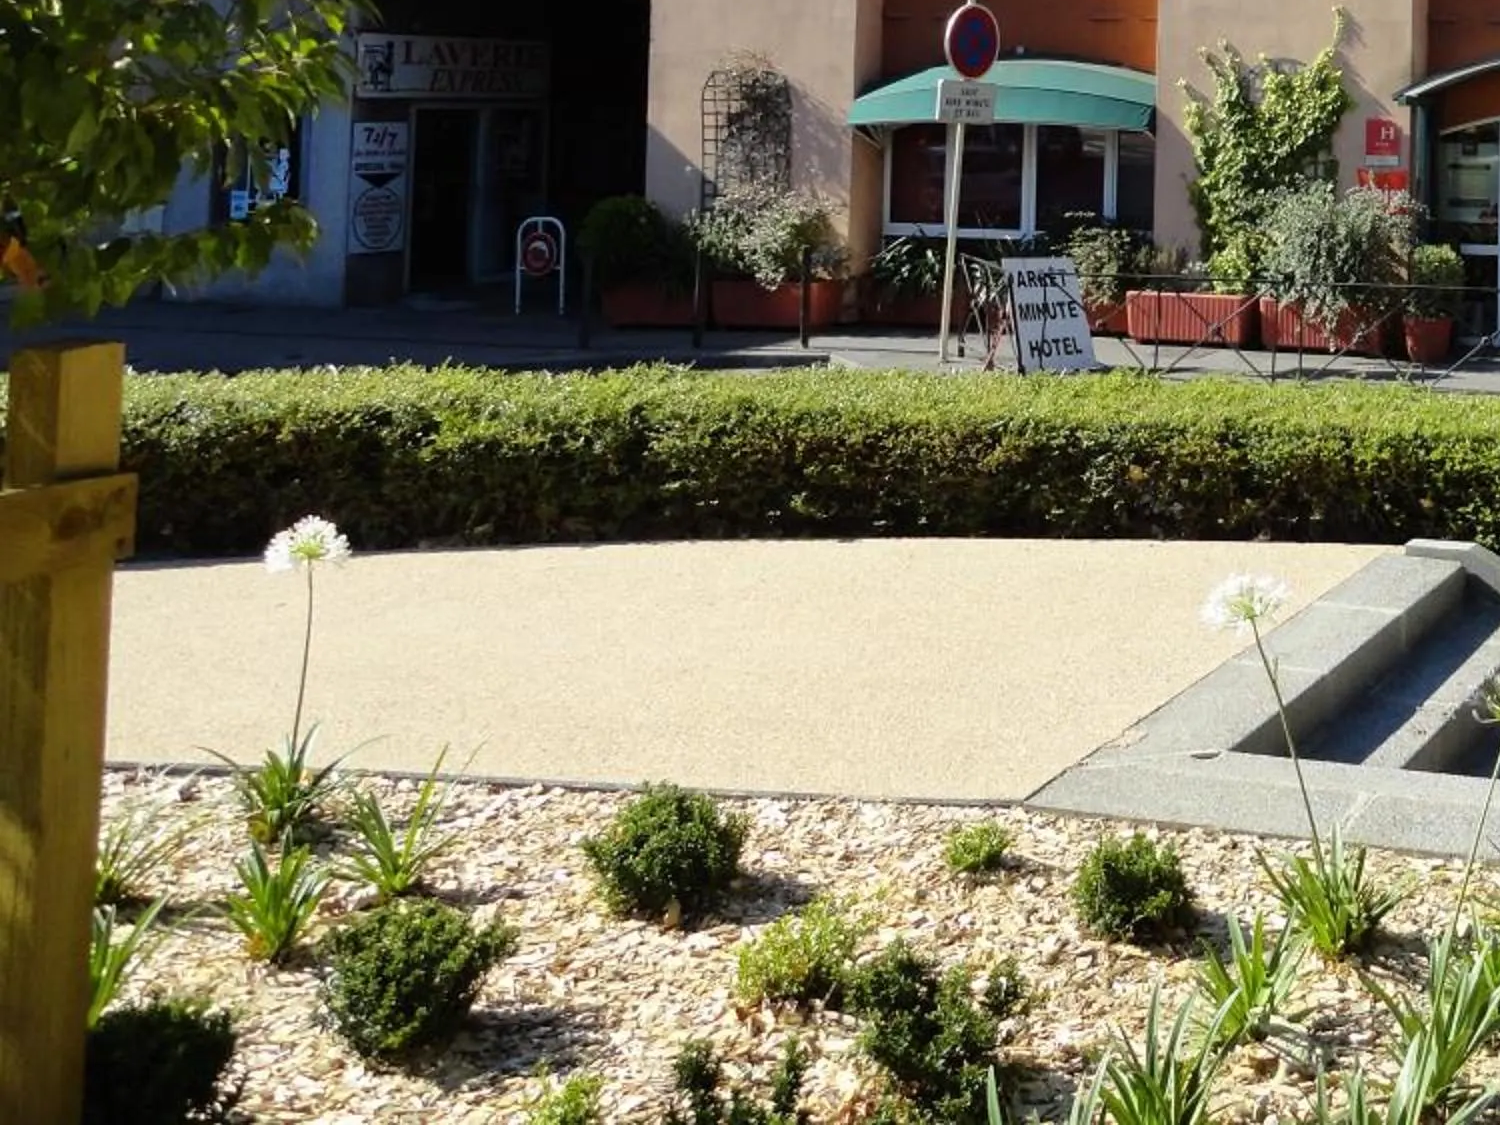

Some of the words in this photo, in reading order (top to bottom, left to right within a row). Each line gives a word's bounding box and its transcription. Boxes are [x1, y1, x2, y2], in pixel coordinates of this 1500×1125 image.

[401, 41, 544, 69] LAVERIE
[1381, 126, 1395, 140] H
[1018, 301, 1079, 321] MINUTE
[1029, 337, 1083, 359] HOTEL
